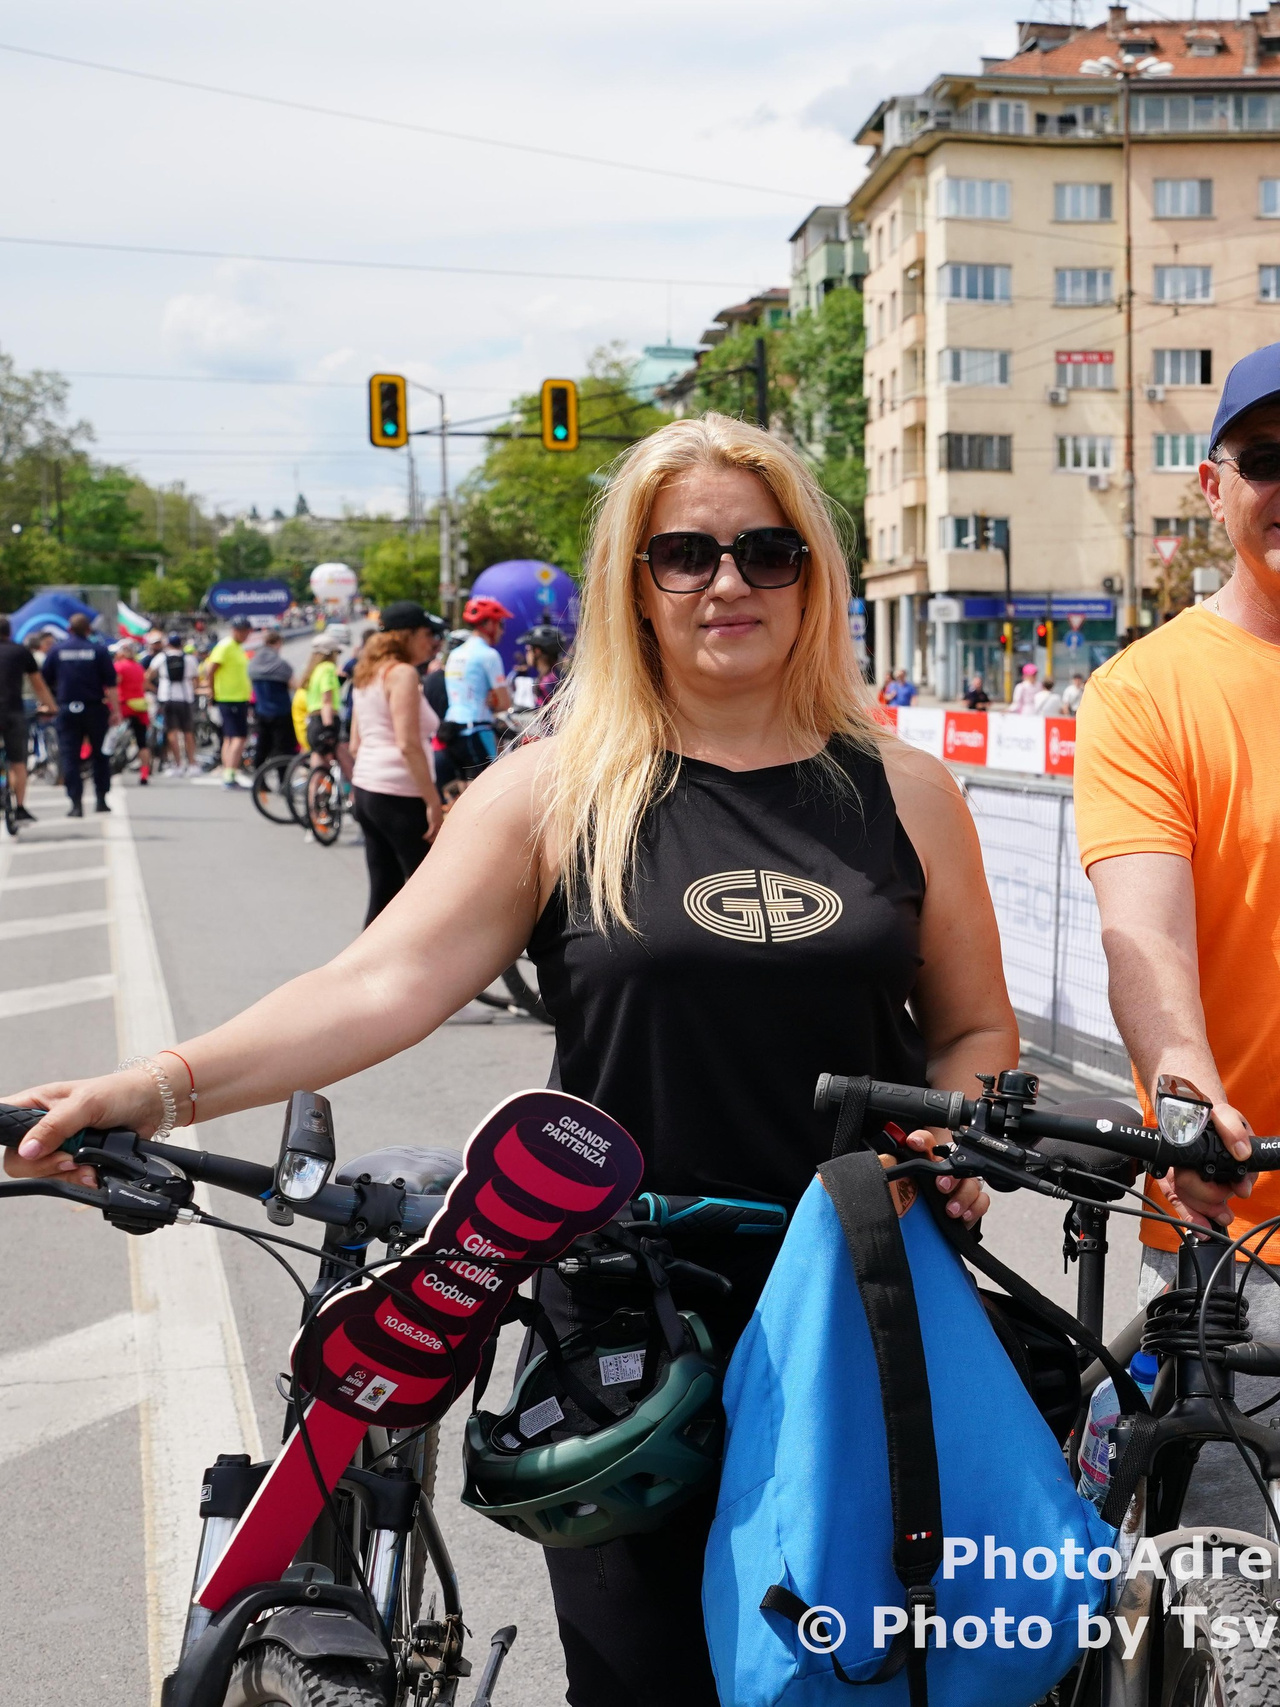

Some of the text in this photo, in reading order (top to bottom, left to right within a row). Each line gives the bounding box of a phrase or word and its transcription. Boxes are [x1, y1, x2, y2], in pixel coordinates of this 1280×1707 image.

[541, 1122, 607, 1168] PARTENZA
[558, 1115, 612, 1153] GRANDE
[422, 1273, 477, 1309] София
[383, 1315, 443, 1350] 10.05.2026
